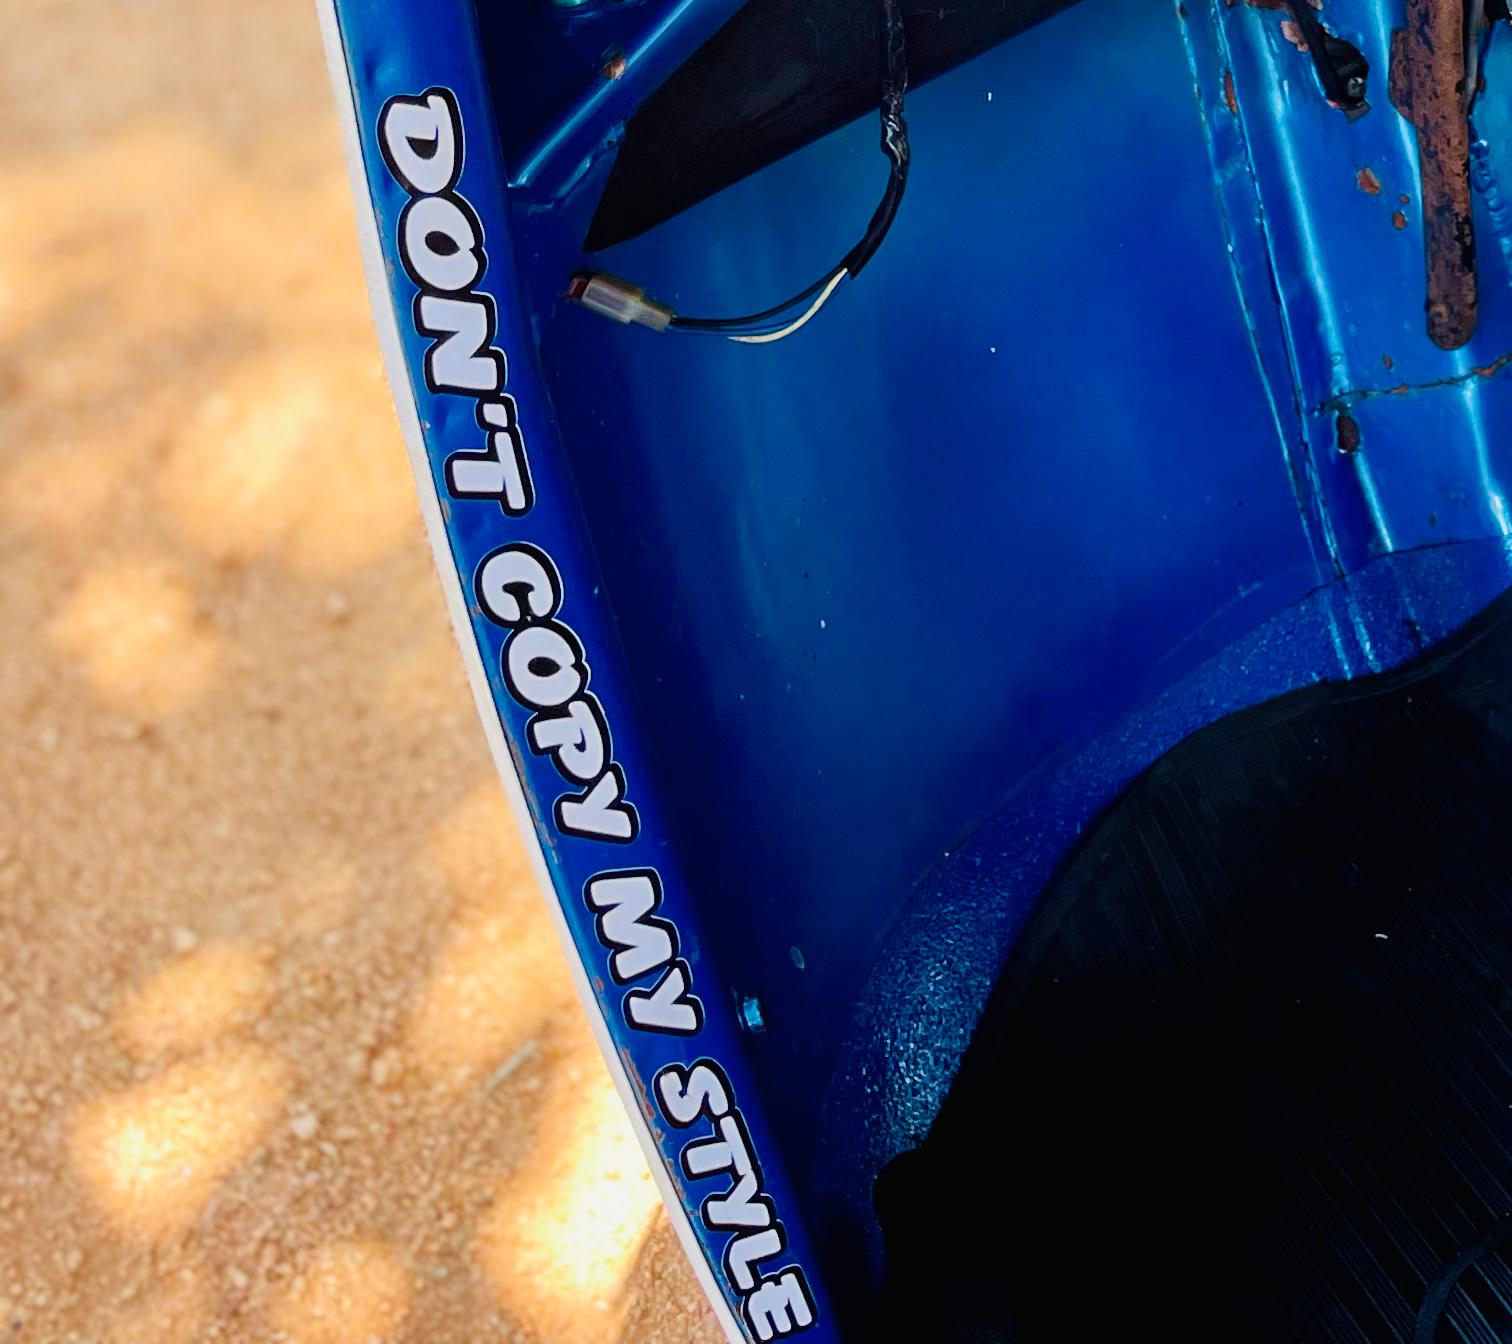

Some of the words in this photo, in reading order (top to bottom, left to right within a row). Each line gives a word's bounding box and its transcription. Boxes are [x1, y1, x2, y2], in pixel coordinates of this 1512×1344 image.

[381, 90, 529, 515] DON'T
[475, 547, 635, 842] COPY
[587, 872, 700, 1034] MY
[656, 1061, 814, 1343] STYLE
